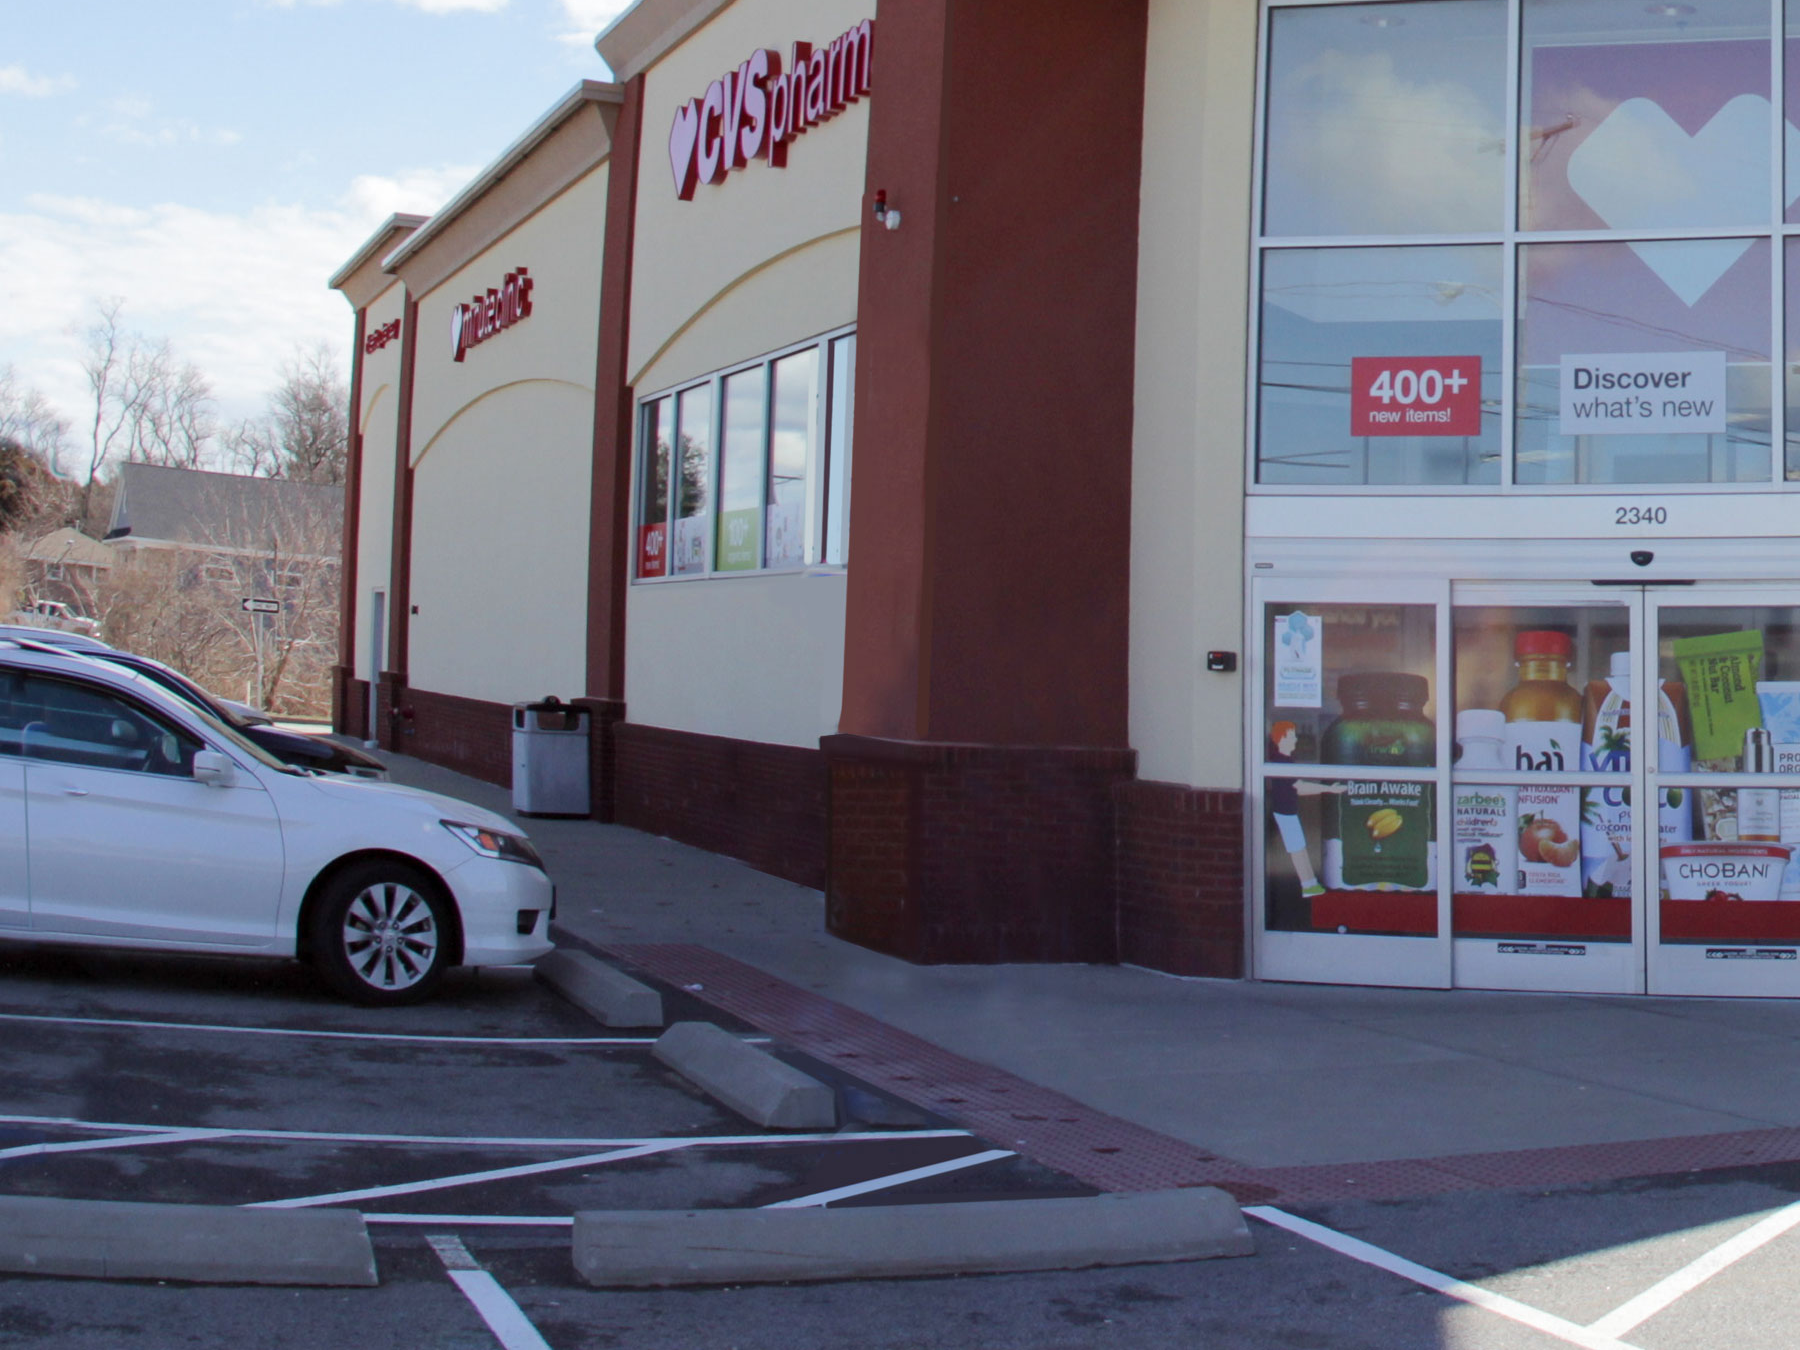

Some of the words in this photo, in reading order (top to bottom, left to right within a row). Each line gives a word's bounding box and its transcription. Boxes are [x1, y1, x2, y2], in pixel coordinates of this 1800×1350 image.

[698, 48, 782, 186] CVS
[768, 18, 876, 168] pharm
[1369, 368, 1469, 406] 400+
[1574, 367, 1692, 392] Discover
[1369, 410, 1401, 423] new
[1404, 407, 1452, 423] items!
[1573, 395, 1653, 419] what's
[1661, 401, 1714, 418] new
[1614, 506, 1668, 526] 2340
[1729, 656, 1746, 692] Almond
[1709, 676, 1720, 694] Bar
[1347, 780, 1378, 796] Brain
[1380, 781, 1422, 796] Awake
[1456, 791, 1507, 807] zarbee's
[1518, 795, 1558, 805] NFUSION
[1456, 808, 1506, 817] NATURALS
[1658, 824, 1678, 833] ater
[1679, 862, 1769, 879] CHOBANI
